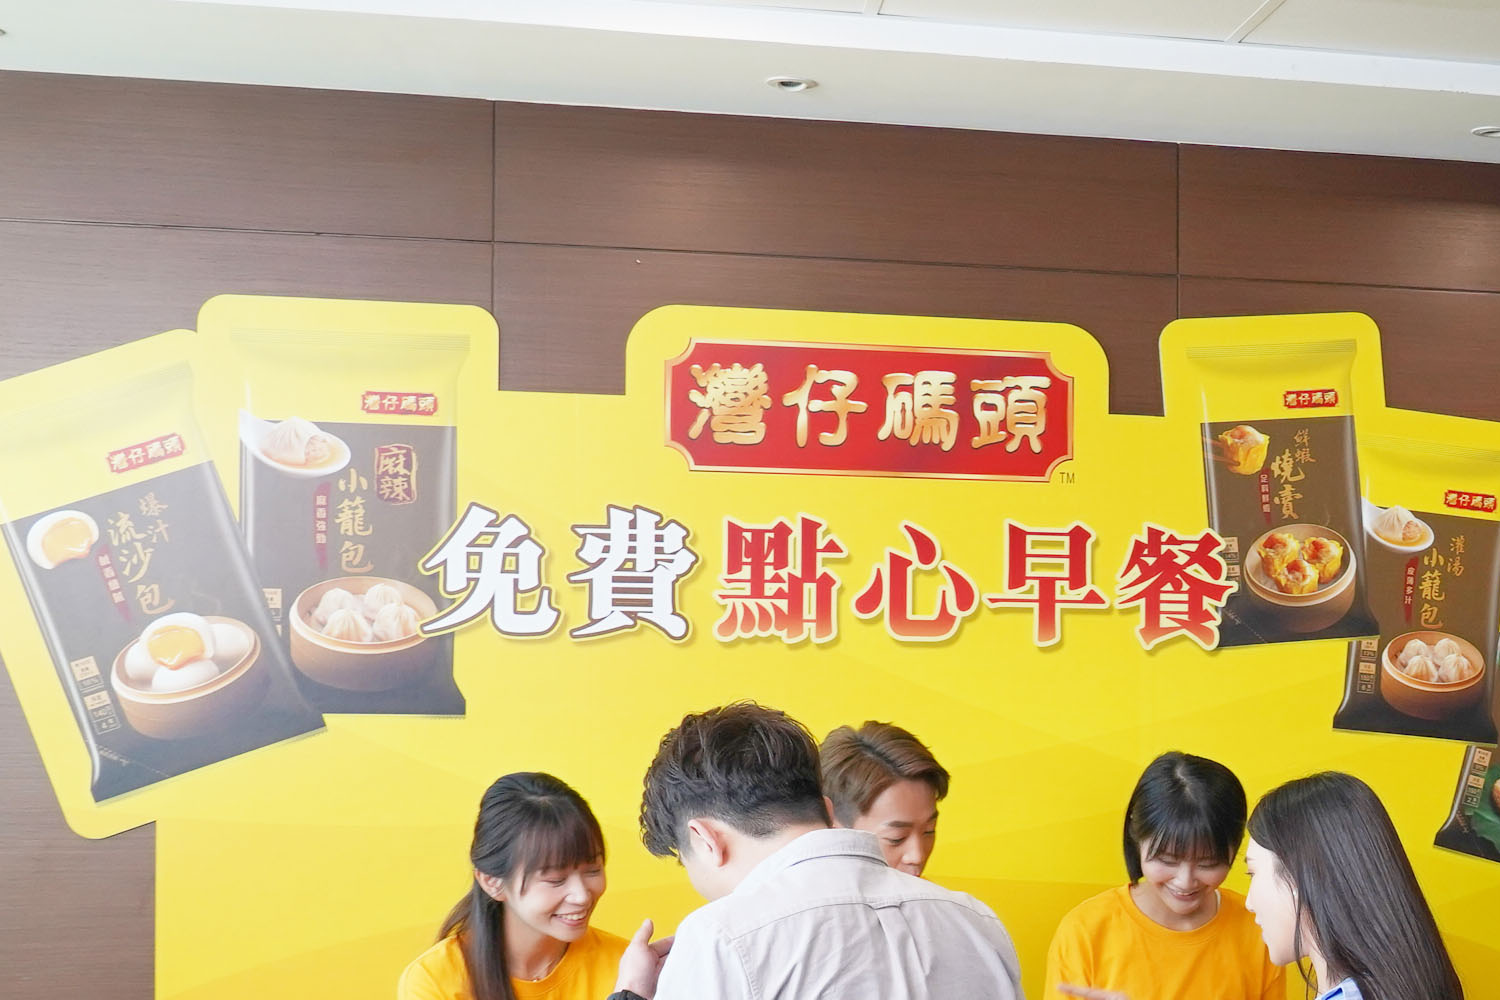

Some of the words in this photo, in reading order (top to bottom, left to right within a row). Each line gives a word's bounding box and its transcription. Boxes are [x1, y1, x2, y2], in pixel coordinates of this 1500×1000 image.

[363, 394, 435, 413] 灣仔碼頭
[688, 362, 1051, 453] 灣仔碼頭
[378, 446, 412, 501] 麻辣
[1271, 448, 1306, 520] 燒賣
[334, 468, 375, 573] 小籠包
[1447, 535, 1465, 577] 灌湯
[107, 511, 176, 615] 流沙包
[418, 500, 1239, 653] 免費點心早餐
[1418, 547, 1446, 630] 小籠包
